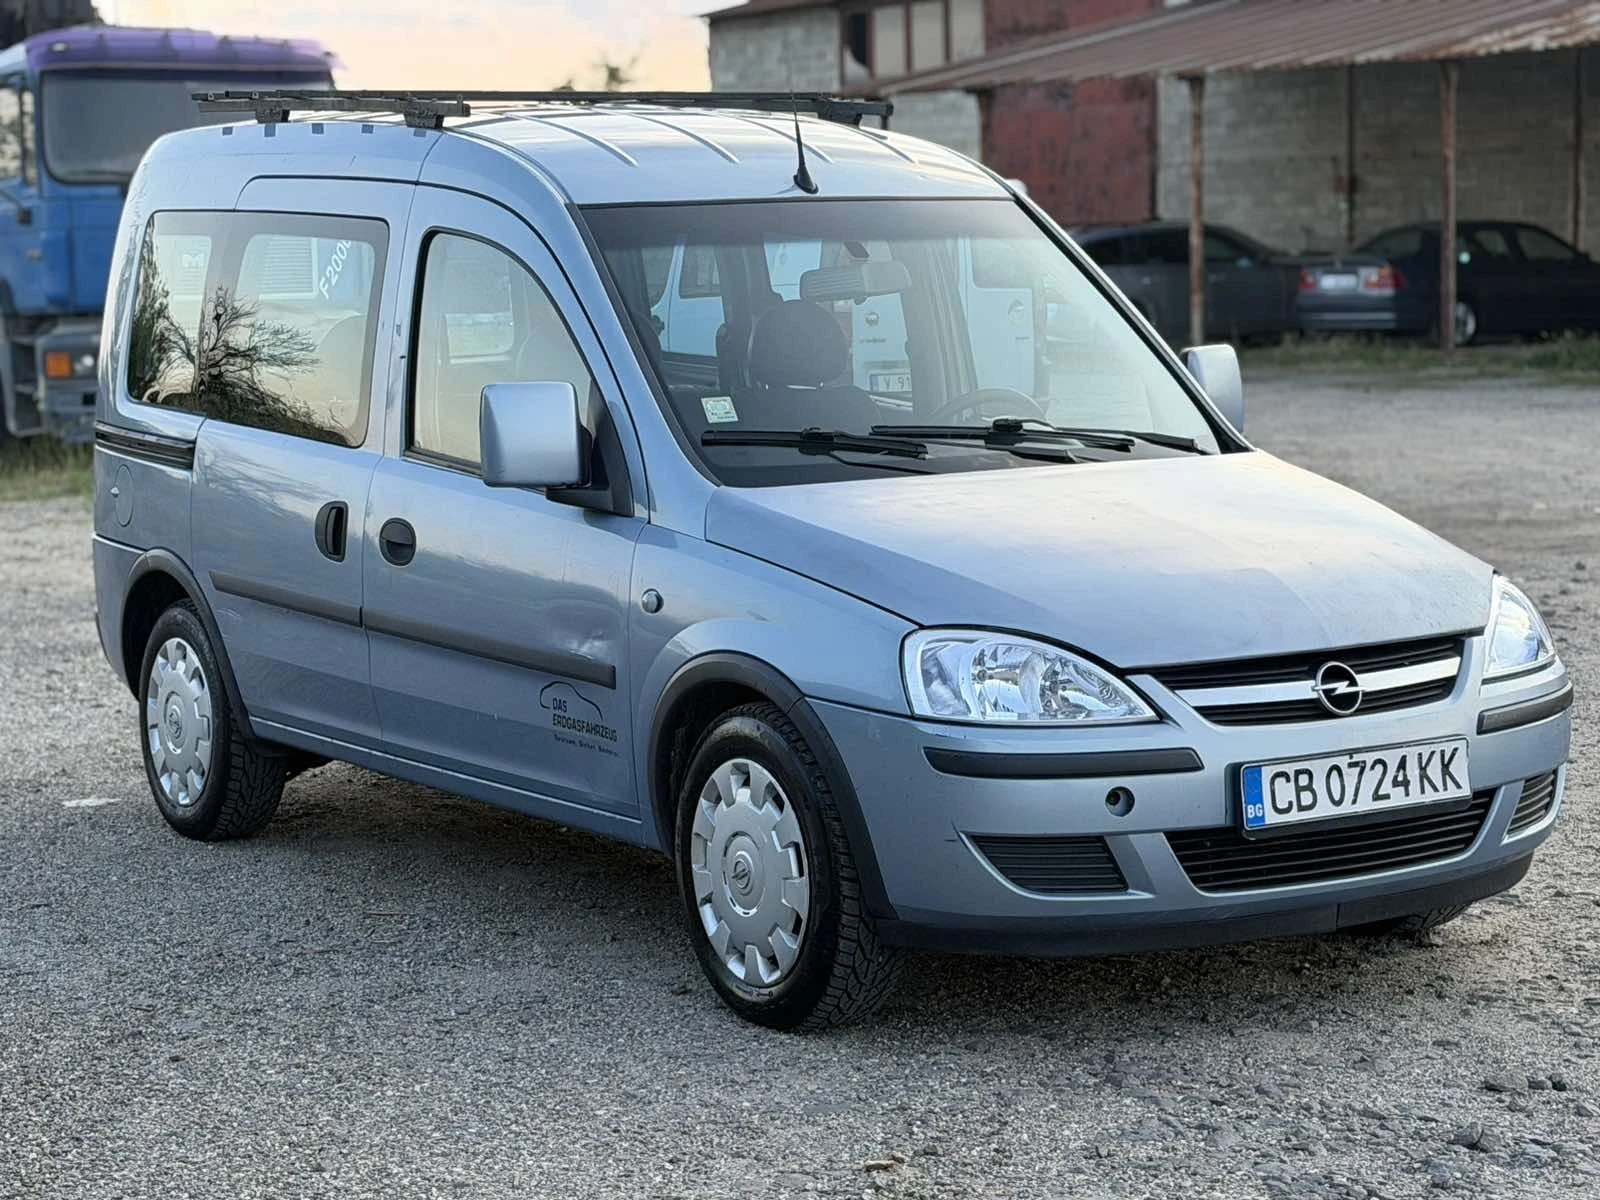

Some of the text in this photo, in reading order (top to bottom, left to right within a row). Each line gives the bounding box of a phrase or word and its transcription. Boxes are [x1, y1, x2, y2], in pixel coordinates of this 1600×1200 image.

[552, 697, 568, 713] DAS
[552, 713, 618, 742] ERDGASFAHRZEUG
[1269, 747, 1463, 815] CB 0724 KK
[1247, 804, 1263, 818] BG
